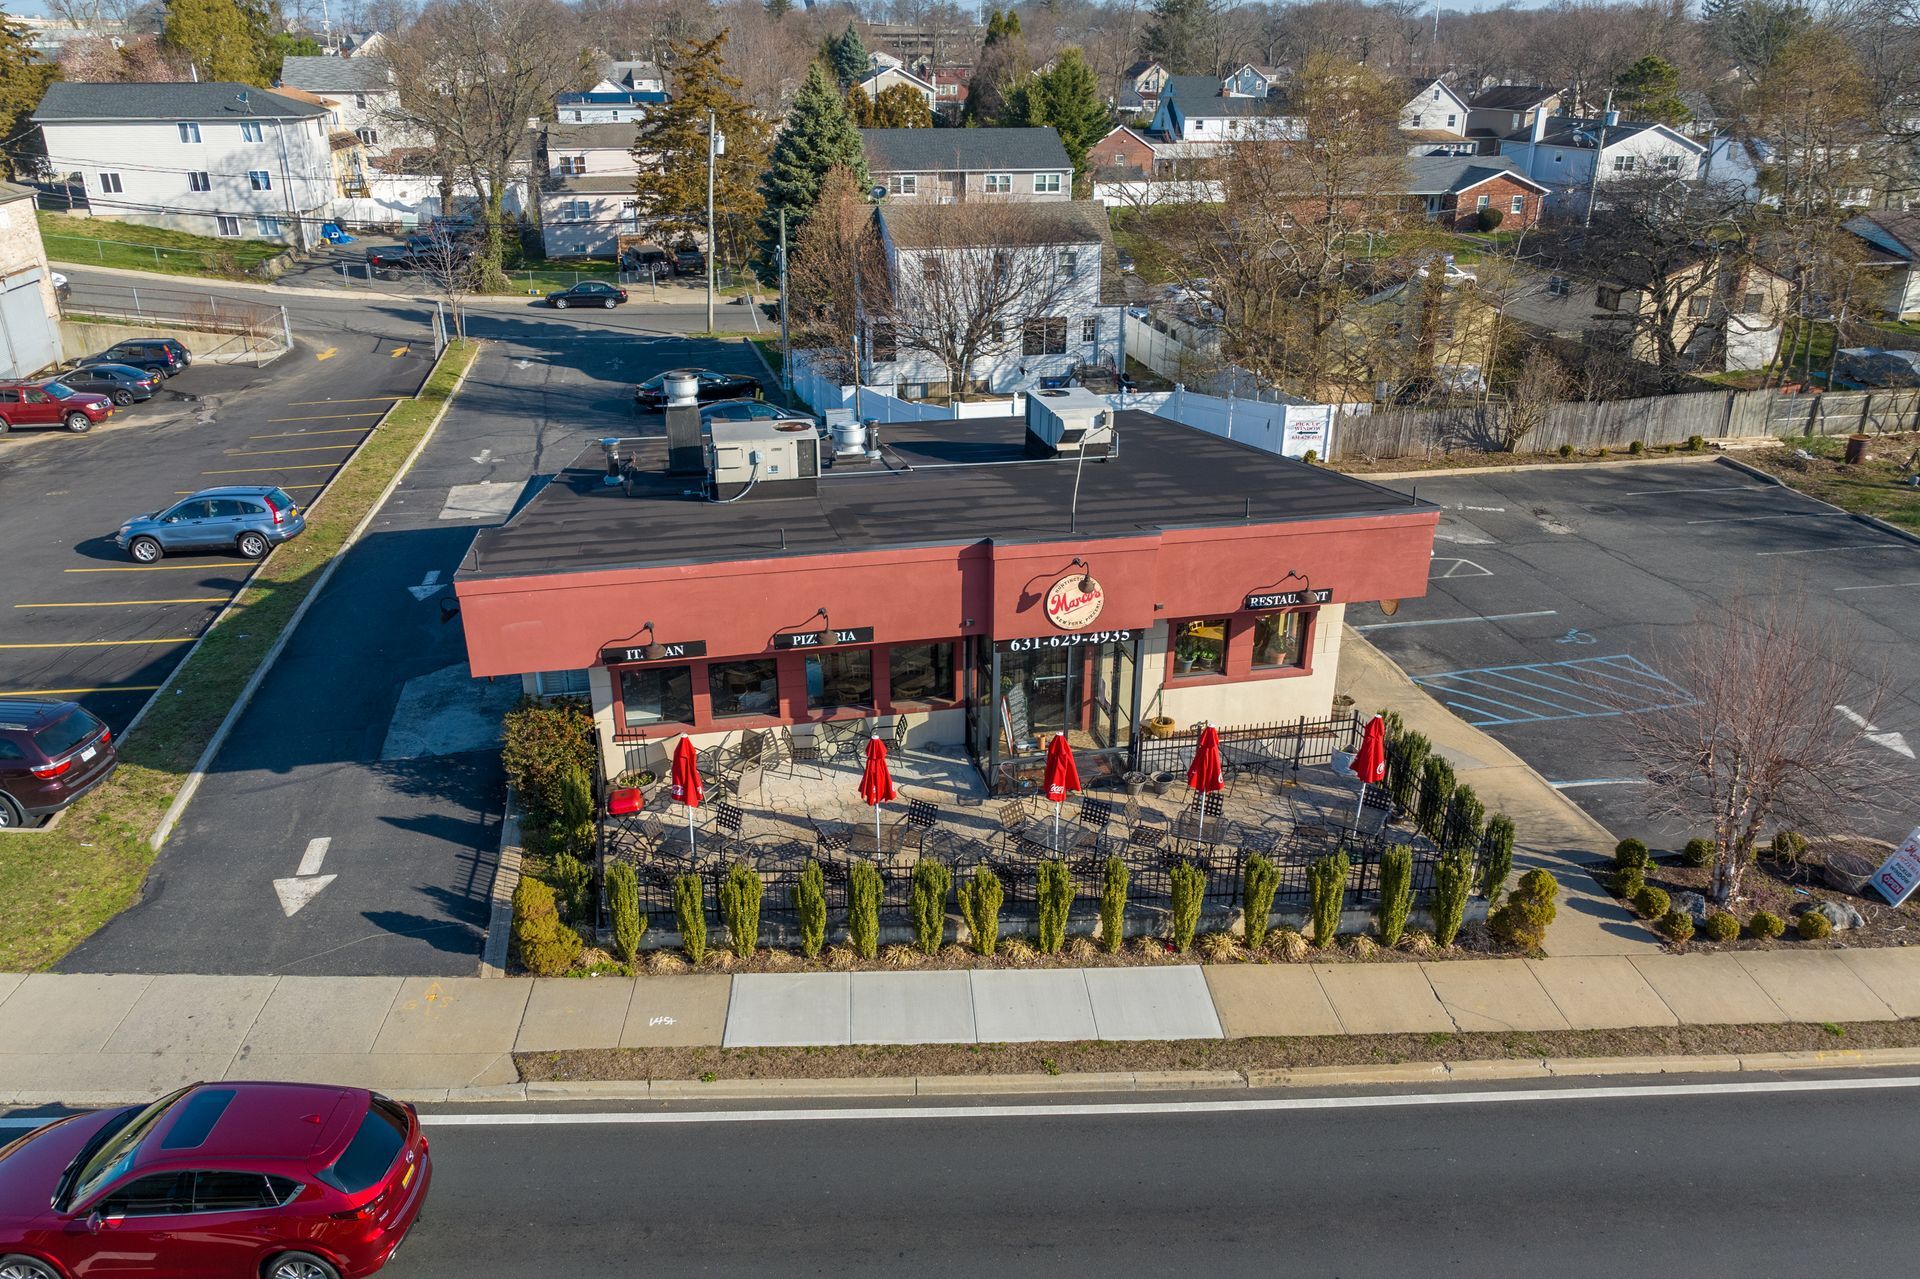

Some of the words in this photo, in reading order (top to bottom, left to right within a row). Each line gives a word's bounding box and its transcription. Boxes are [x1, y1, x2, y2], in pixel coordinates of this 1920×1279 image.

[1250, 591, 1329, 607] RESTAUNT
[792, 631, 857, 646] PIZRIA
[1010, 630, 1130, 652] 631-629-4935
[625, 645, 684, 660] ITAN
[1883, 876, 1902, 893] OPEN
